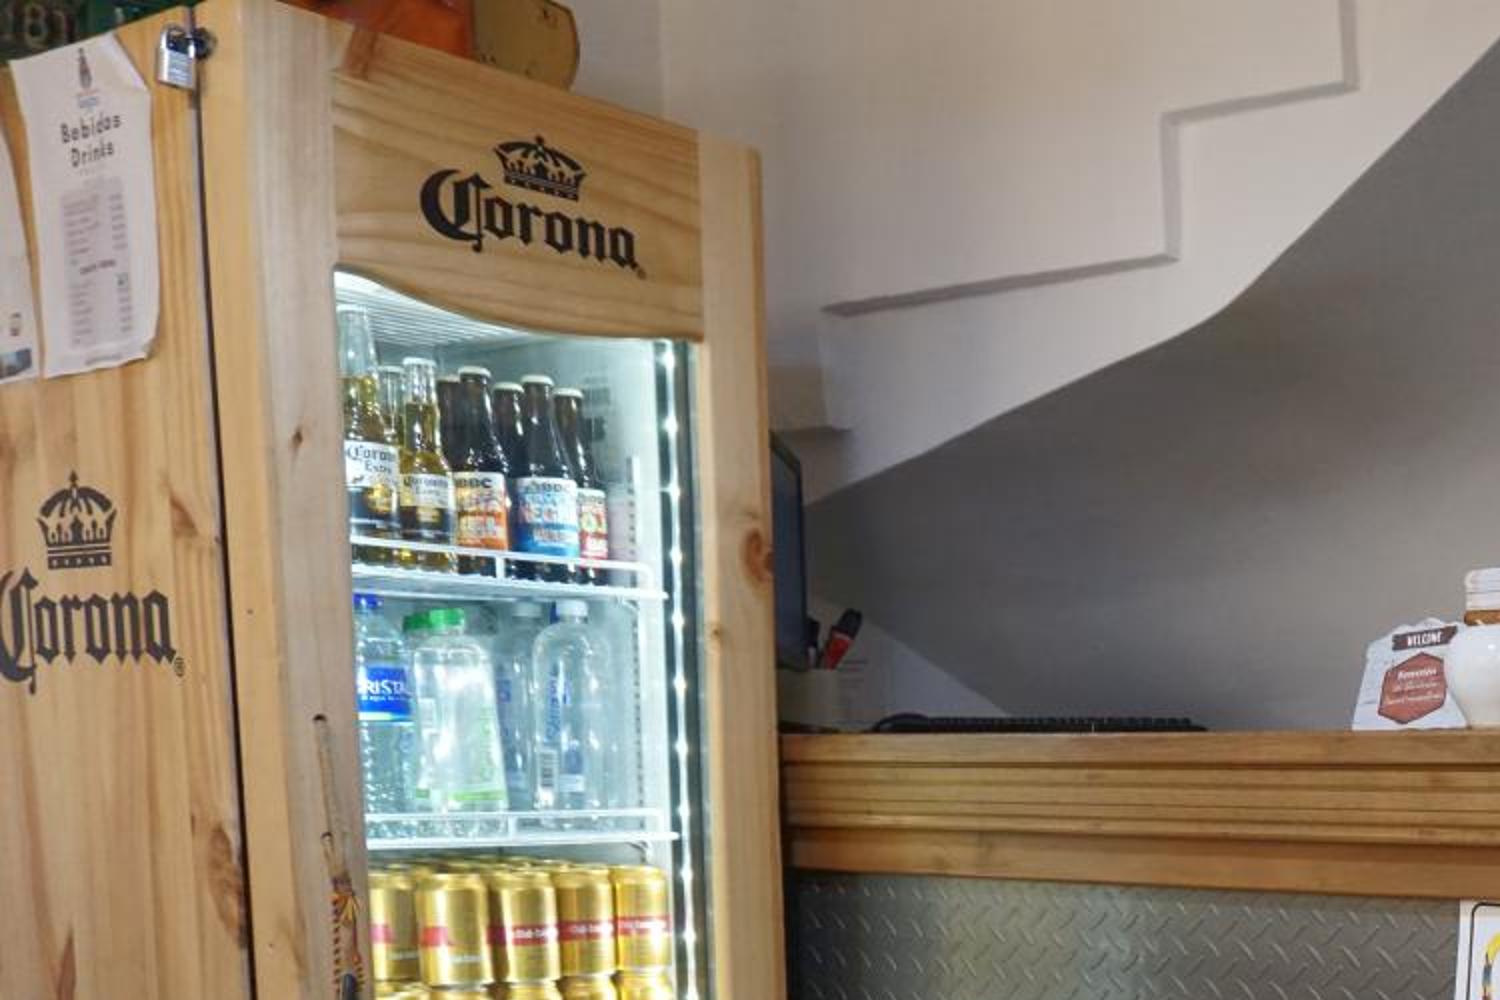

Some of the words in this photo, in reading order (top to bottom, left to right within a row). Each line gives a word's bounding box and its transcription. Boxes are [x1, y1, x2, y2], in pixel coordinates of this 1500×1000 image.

[60, 114, 121, 143] Bebidas
[71, 141, 114, 167] Drinks
[420, 169, 641, 273] Corona
[0, 567, 177, 695] Corona
[1407, 631, 1443, 647] WELCOME
